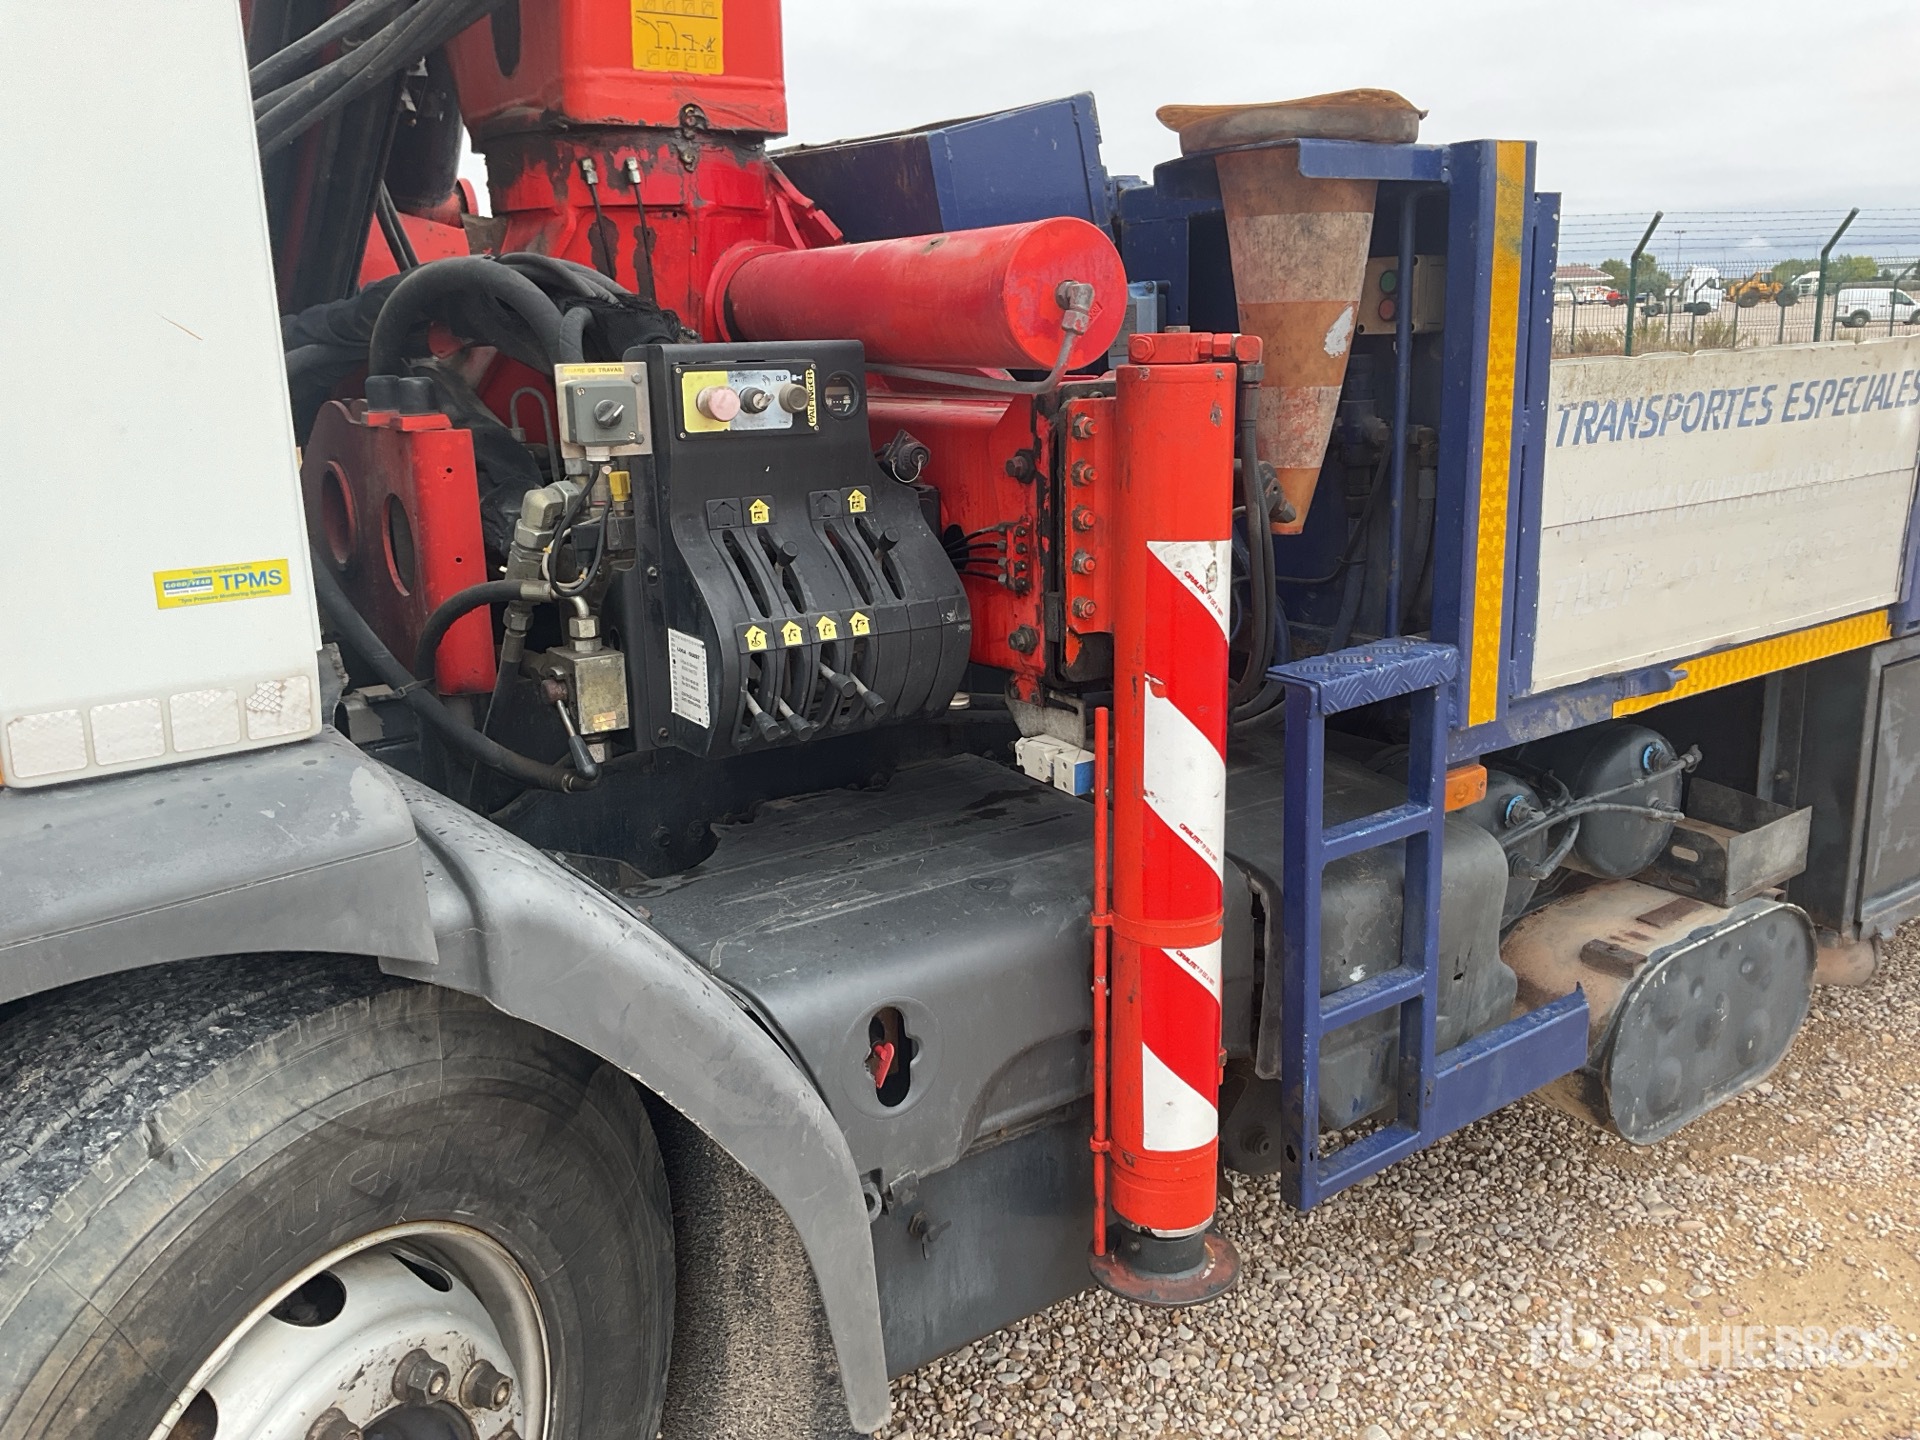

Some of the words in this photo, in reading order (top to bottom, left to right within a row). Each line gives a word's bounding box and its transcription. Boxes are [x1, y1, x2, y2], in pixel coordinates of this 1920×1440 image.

[775, 374, 788, 382] OLP
[1555, 383, 1778, 448] TRANSPORTES
[1781, 369, 1920, 423] ESPECIALES
[219, 569, 282, 591] TPMS
